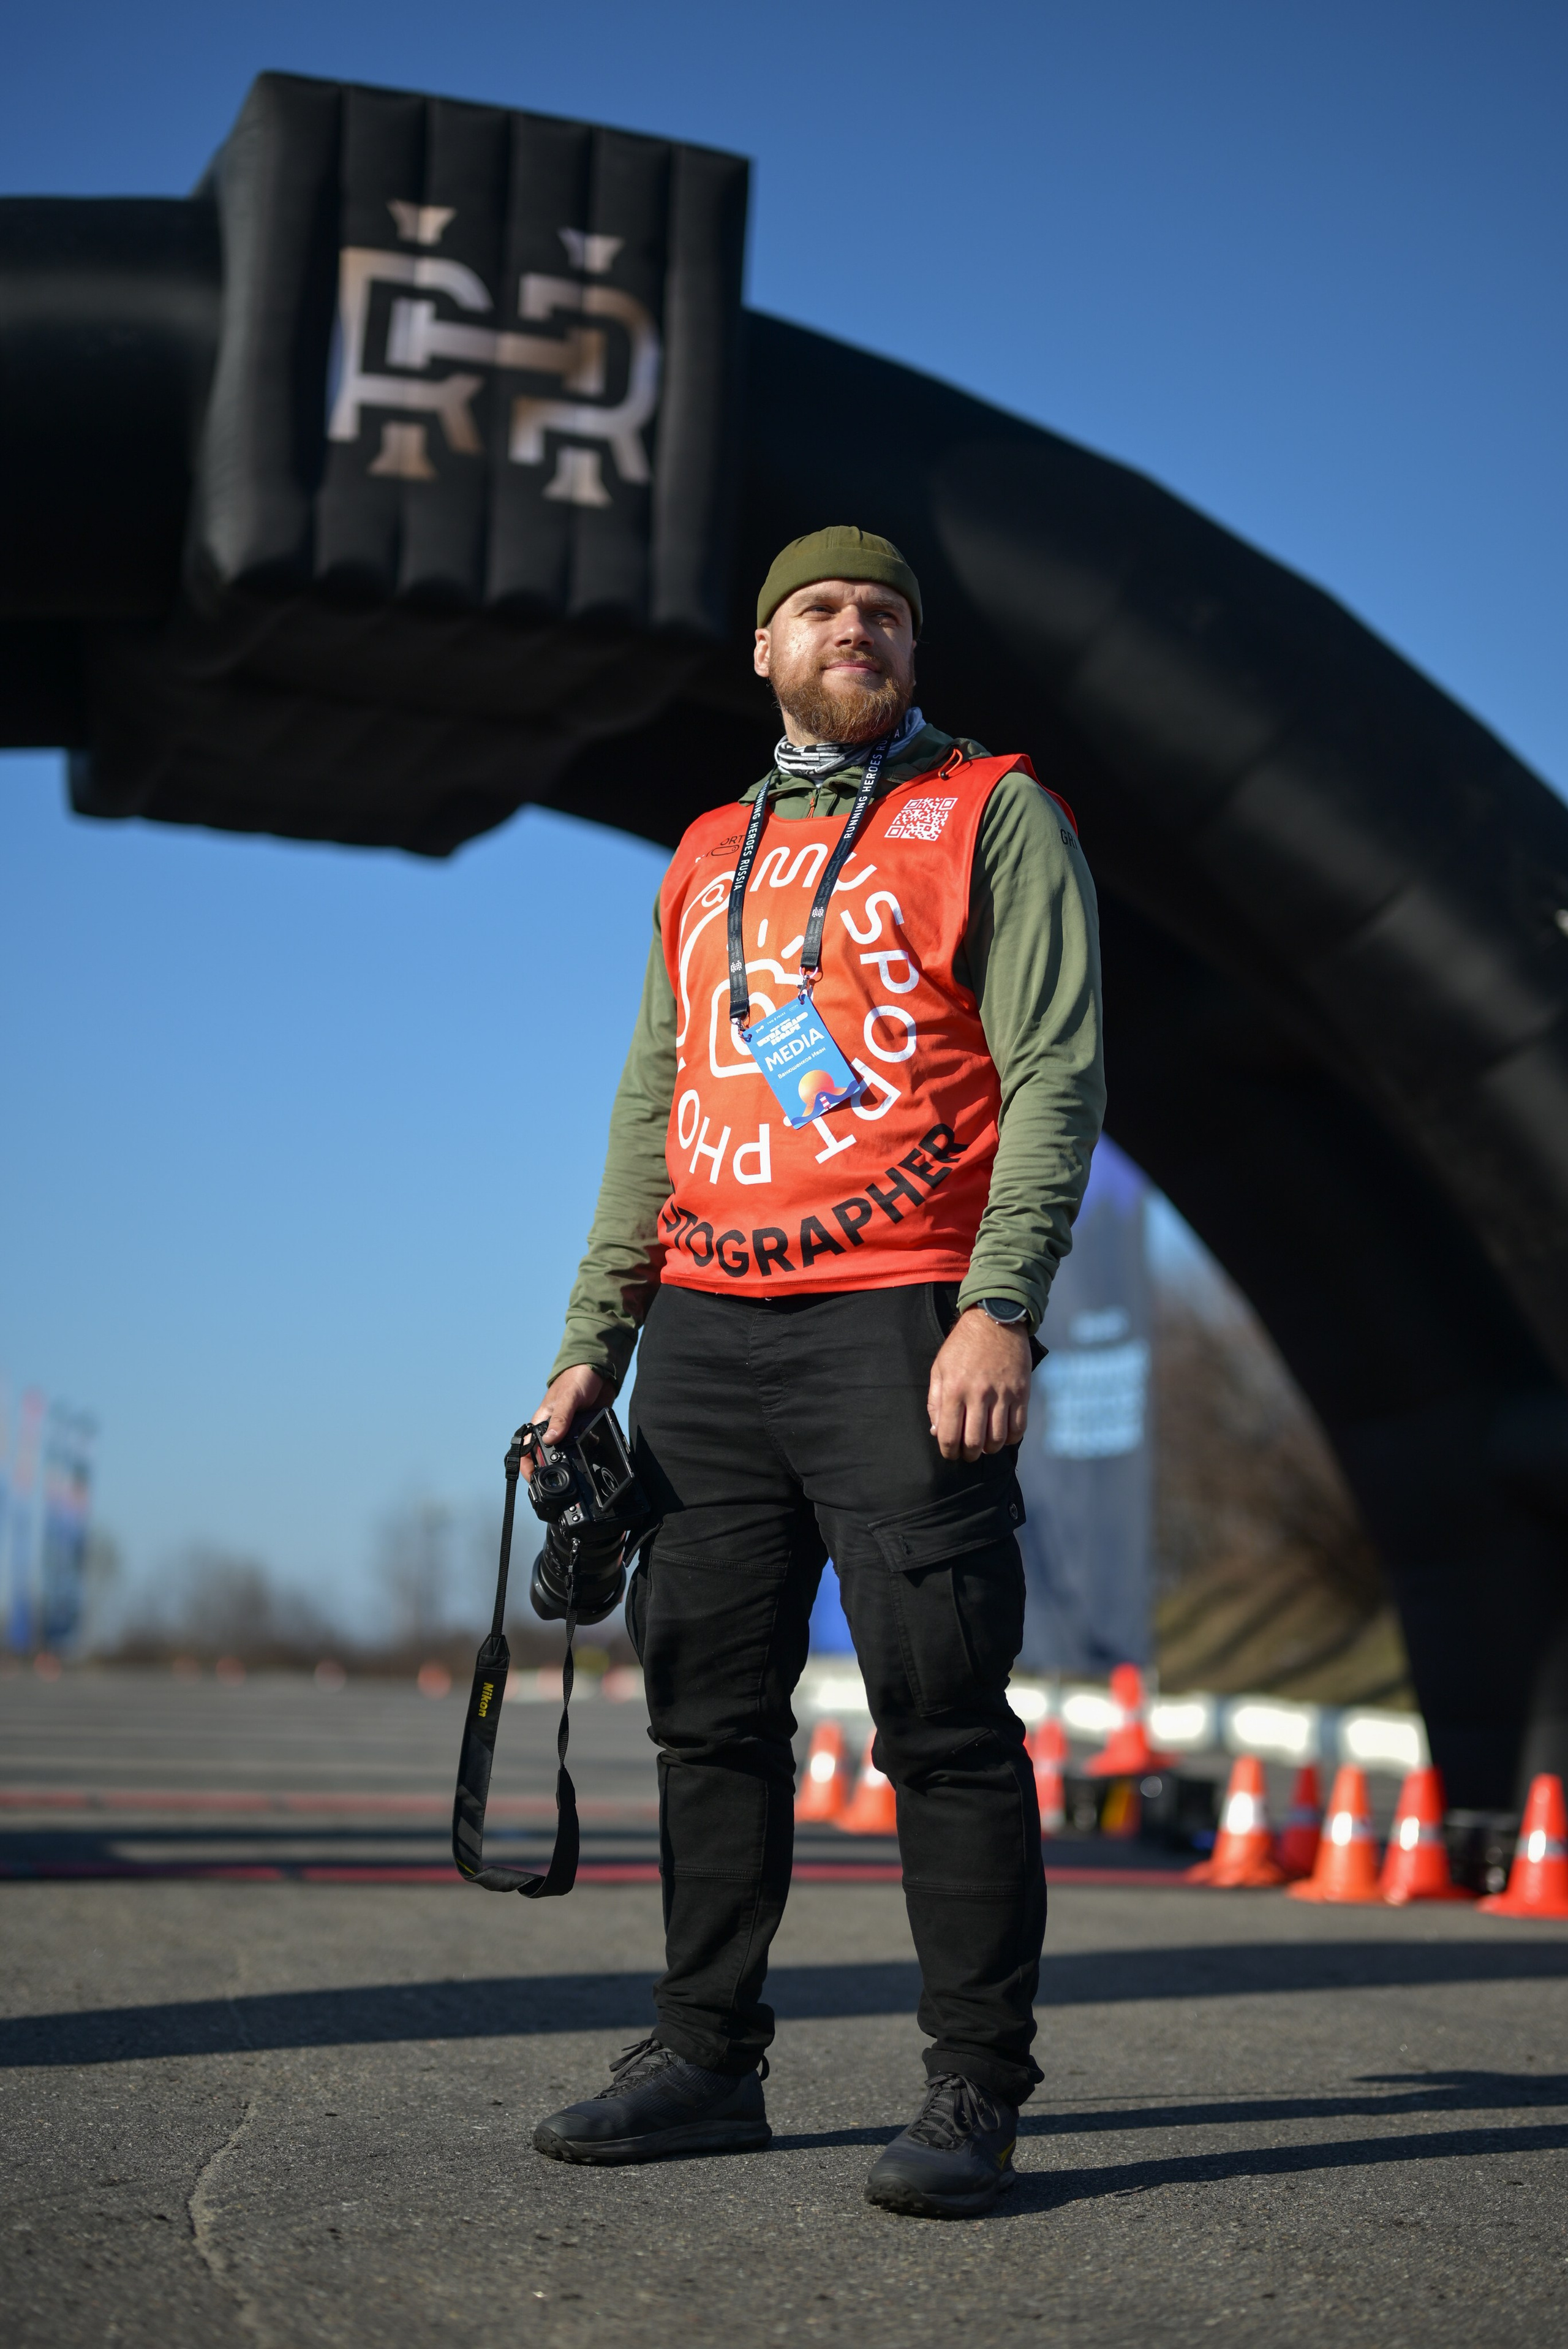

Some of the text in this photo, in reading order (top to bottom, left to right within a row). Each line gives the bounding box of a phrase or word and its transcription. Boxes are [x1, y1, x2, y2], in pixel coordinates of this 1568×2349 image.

[753, 780, 769, 820] RUNNING
[844, 796, 868, 839] RUNNING
[862, 754, 882, 792] HEROES
[743, 822, 759, 857] HEROES
[734, 859, 750, 891] RUSSIA
[764, 1027, 825, 1072] MEDIA
[777, 1046, 826, 1080] Ванюшенков Иван
[478, 1682, 494, 1717] Nikon
